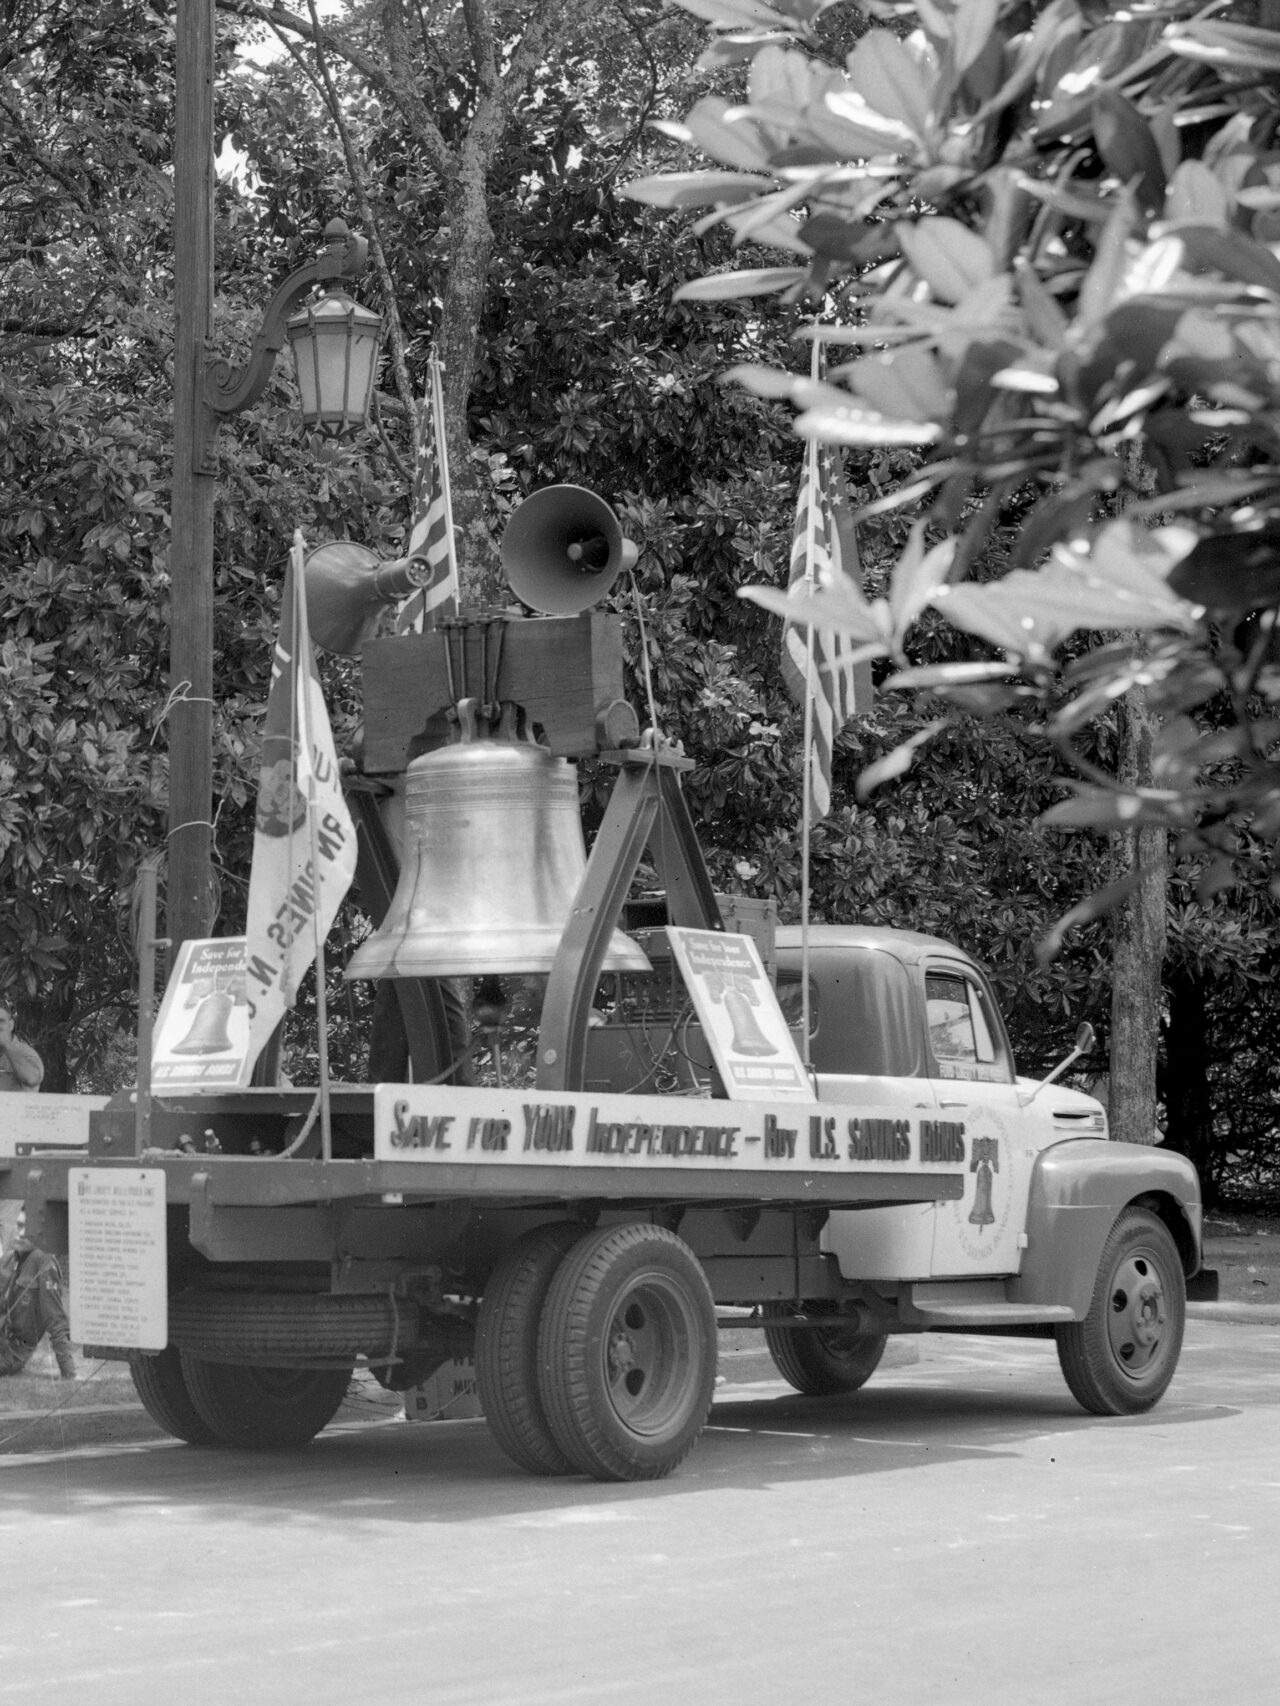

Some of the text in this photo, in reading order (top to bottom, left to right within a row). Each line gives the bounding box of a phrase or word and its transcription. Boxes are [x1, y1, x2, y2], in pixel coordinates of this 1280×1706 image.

[200, 948, 225, 960] Save
[226, 946, 242, 959] for
[467, 1117, 512, 1151] FOR
[522, 1104, 576, 1151] YOUR
[848, 1117, 911, 1161] SAVINGS
[919, 1119, 965, 1162] BONDS
